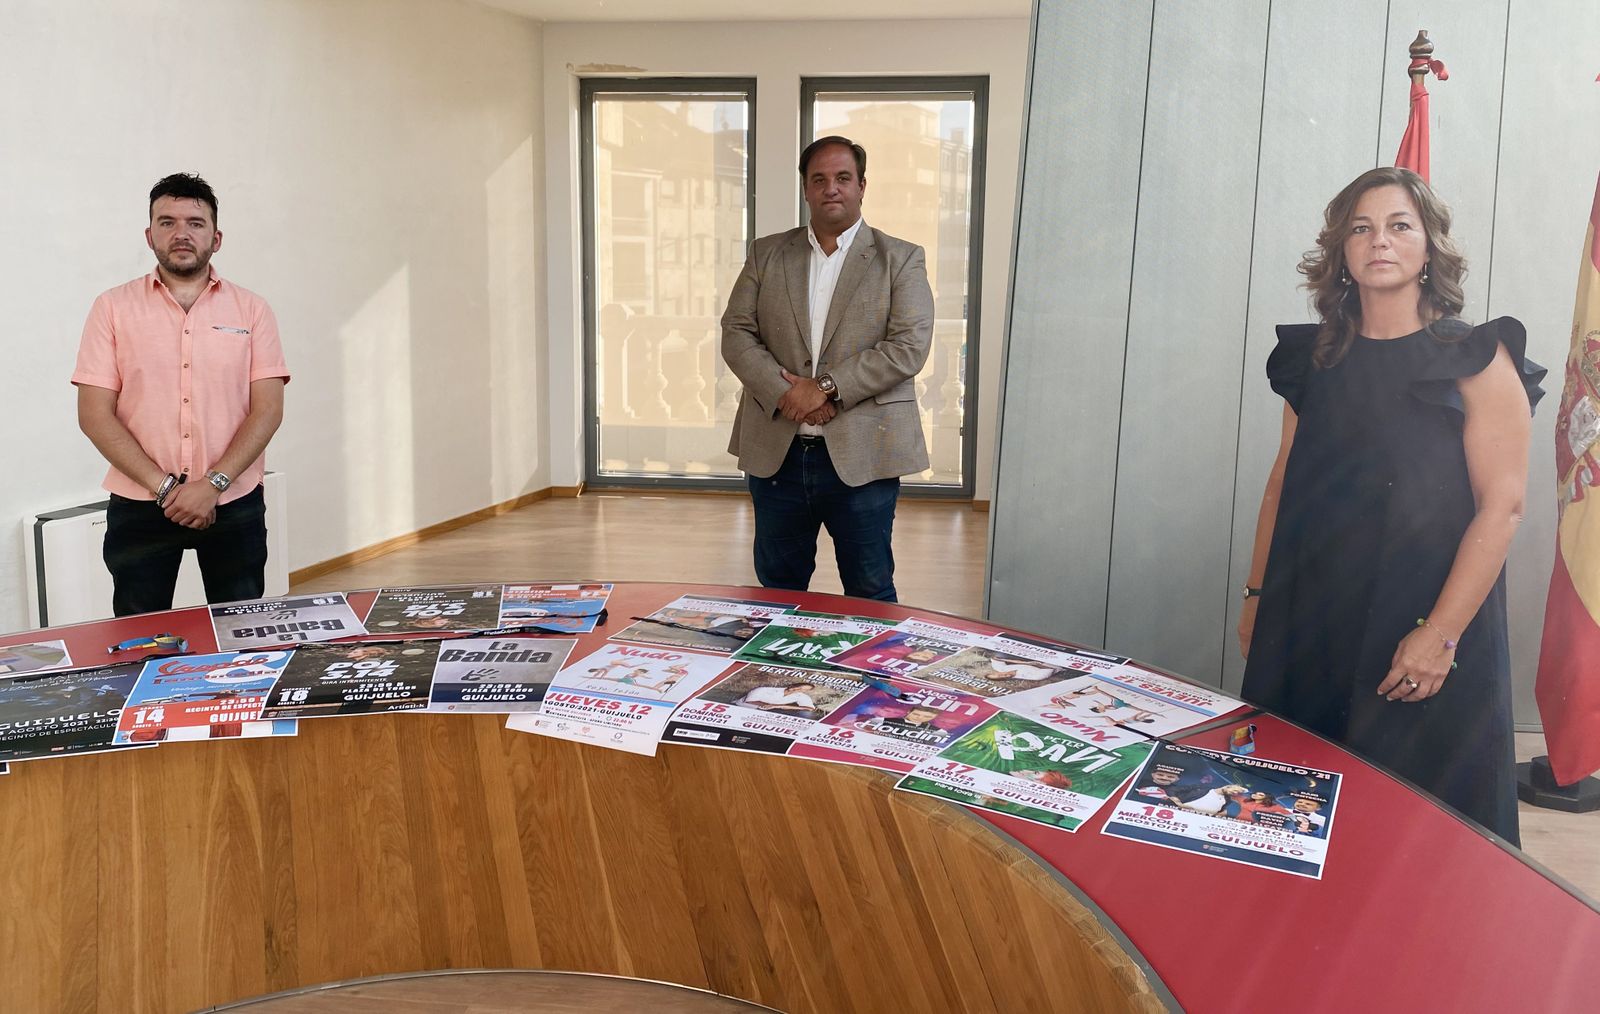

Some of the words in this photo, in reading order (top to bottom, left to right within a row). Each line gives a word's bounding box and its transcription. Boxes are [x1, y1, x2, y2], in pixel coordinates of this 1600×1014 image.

[232, 619, 345, 638] Banda
[277, 632, 308, 641] La
[488, 641, 520, 650] La
[905, 637, 960, 652] oudini
[438, 649, 553, 663] Banda
[607, 646, 683, 661] Nudo
[789, 652, 822, 660] PETER
[323, 659, 400, 672] POL
[866, 653, 926, 672] un
[1069, 662, 1094, 672] 15
[319, 669, 394, 680] 3.14
[758, 664, 806, 678] BERTÍN
[1114, 675, 1137, 685] 12
[278, 690, 310, 701] 18
[343, 691, 411, 701] GUIJUELO
[917, 688, 958, 700] Mago
[1139, 682, 1213, 707] JUEVES
[185, 705, 220, 713] RECINTO
[546, 693, 622, 710] JUEVES
[629, 704, 652, 715] 12
[701, 702, 731, 713] 15
[0, 709, 121, 730] GUIJUELO
[133, 708, 165, 724] 14
[677, 712, 728, 724] AGOSTO/21
[682, 707, 732, 719] DOMINGO
[8, 724, 59, 734] AGOSTO
[826, 727, 855, 739] 16
[854, 720, 951, 744] Houdini
[1040, 712, 1120, 743] Nudo
[0, 733, 36, 741] ECINTO
[803, 736, 857, 749] AGOSTO/21
[816, 733, 852, 744] LUNES
[1044, 735, 1084, 749] PETER
[994, 729, 1122, 773] PAN
[1165, 744, 1231, 761] CODY
[1232, 757, 1308, 775] GUIJUELO
[927, 765, 975, 782] MARTES
[945, 762, 977, 774] 17
[917, 769, 976, 787] AGOSTO/21
[1029, 783, 1066, 795] 22:30
[992, 788, 1075, 812] GUIJUELO
[1141, 805, 1175, 820] 18
[1116, 815, 1186, 833] AGOSTO/21
[1117, 810, 1189, 830] MIÉRCOLES
[1240, 824, 1282, 836] 22:30
[1207, 832, 1305, 857] GUIJUELO
